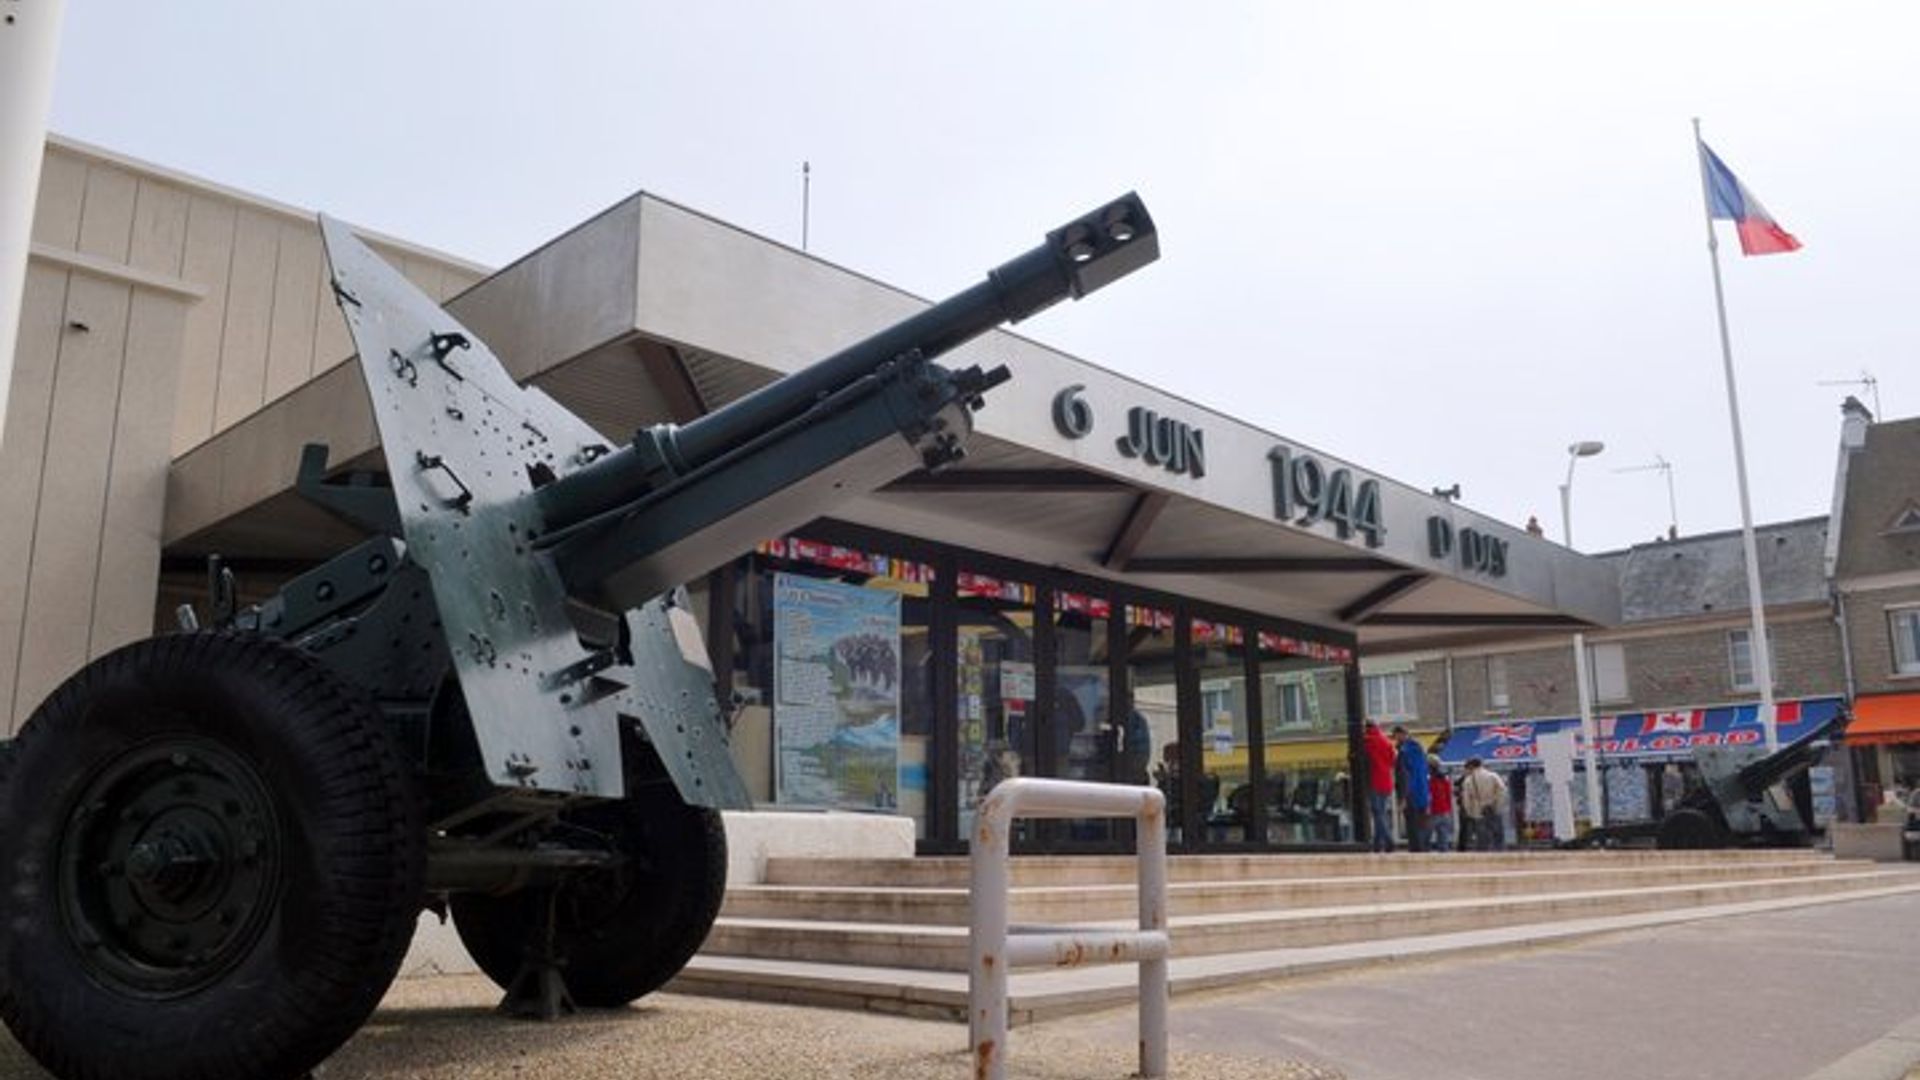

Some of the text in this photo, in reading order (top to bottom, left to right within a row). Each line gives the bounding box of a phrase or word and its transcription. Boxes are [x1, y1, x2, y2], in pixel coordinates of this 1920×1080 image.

[1051, 384, 1094, 440] 6
[1116, 406, 1206, 479] JUIN
[1266, 445, 1388, 549] 1944
[1427, 516, 1453, 559] D
